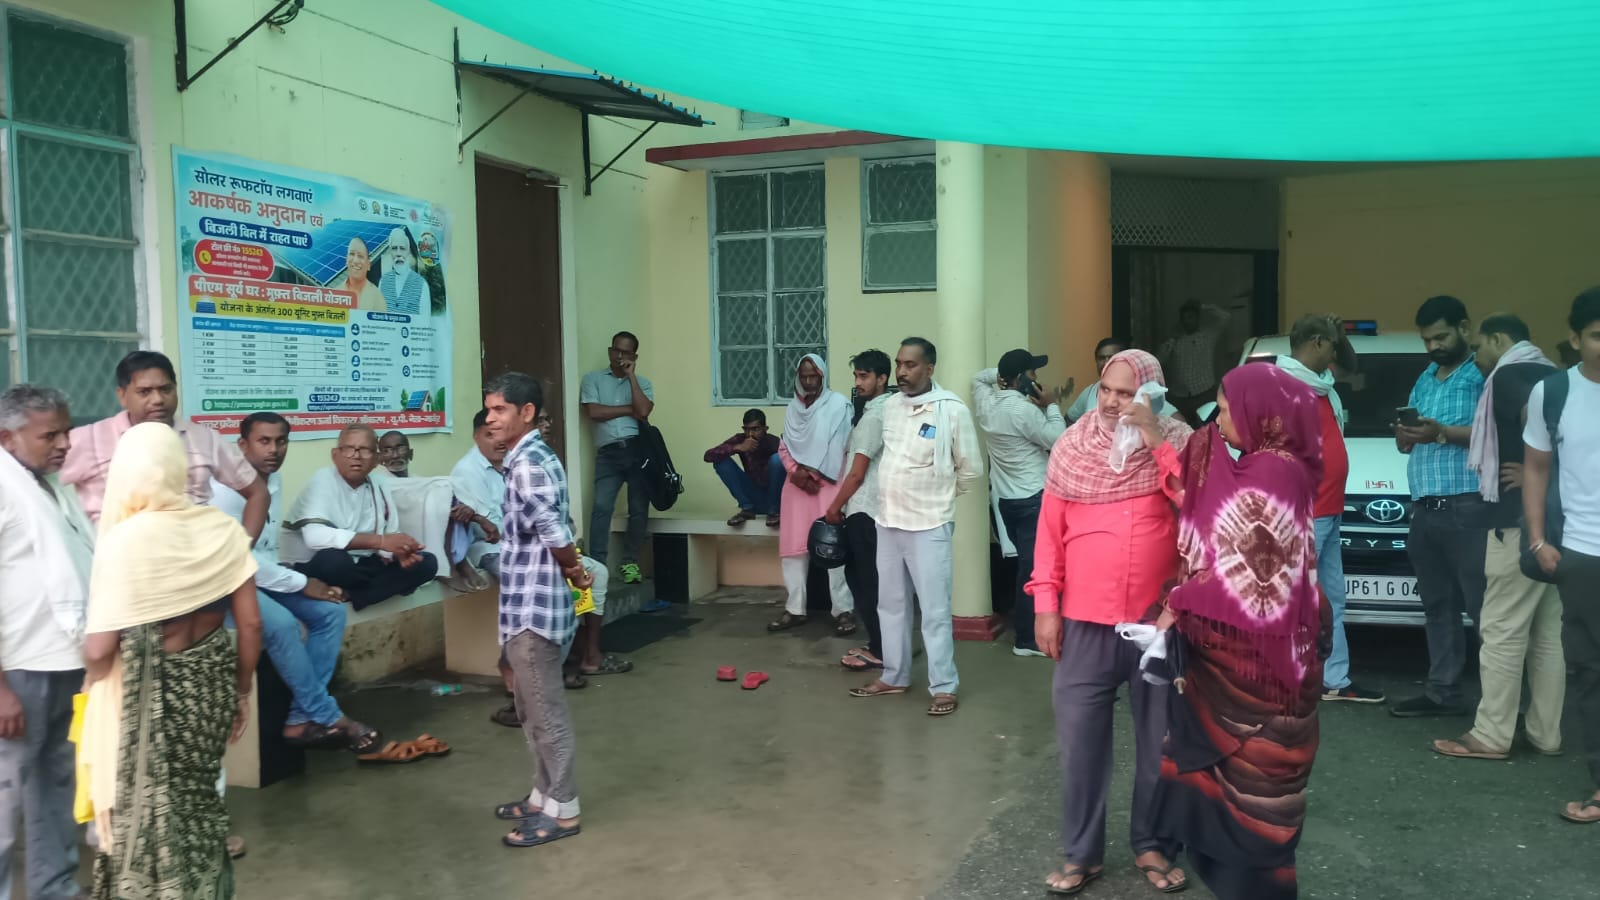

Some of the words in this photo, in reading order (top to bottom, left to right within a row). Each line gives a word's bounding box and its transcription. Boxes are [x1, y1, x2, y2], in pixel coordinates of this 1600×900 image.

[194, 166, 226, 187] सोलर
[230, 176, 273, 196] रूफटॉप
[276, 186, 313, 203] लगवाएं
[189, 190, 252, 214] आकर्षक
[257, 202, 306, 226] अनुदान
[310, 213, 323, 227] एवं
[204, 219, 238, 236] बिजली
[240, 224, 257, 239] बिल
[259, 226, 268, 241] में
[270, 231, 290, 244] राहत
[292, 235, 308, 246] पाएं
[193, 277, 224, 294] पीएम
[225, 281, 243, 298] सूर्य
[246, 286, 260, 297] घर
[293, 287, 322, 302] बिजली
[324, 290, 352, 306] योजना
[220, 302, 244, 313] योजना
[246, 304, 253, 314] के
[278, 308, 292, 316] 300
[1387, 582, 1394, 596] G
